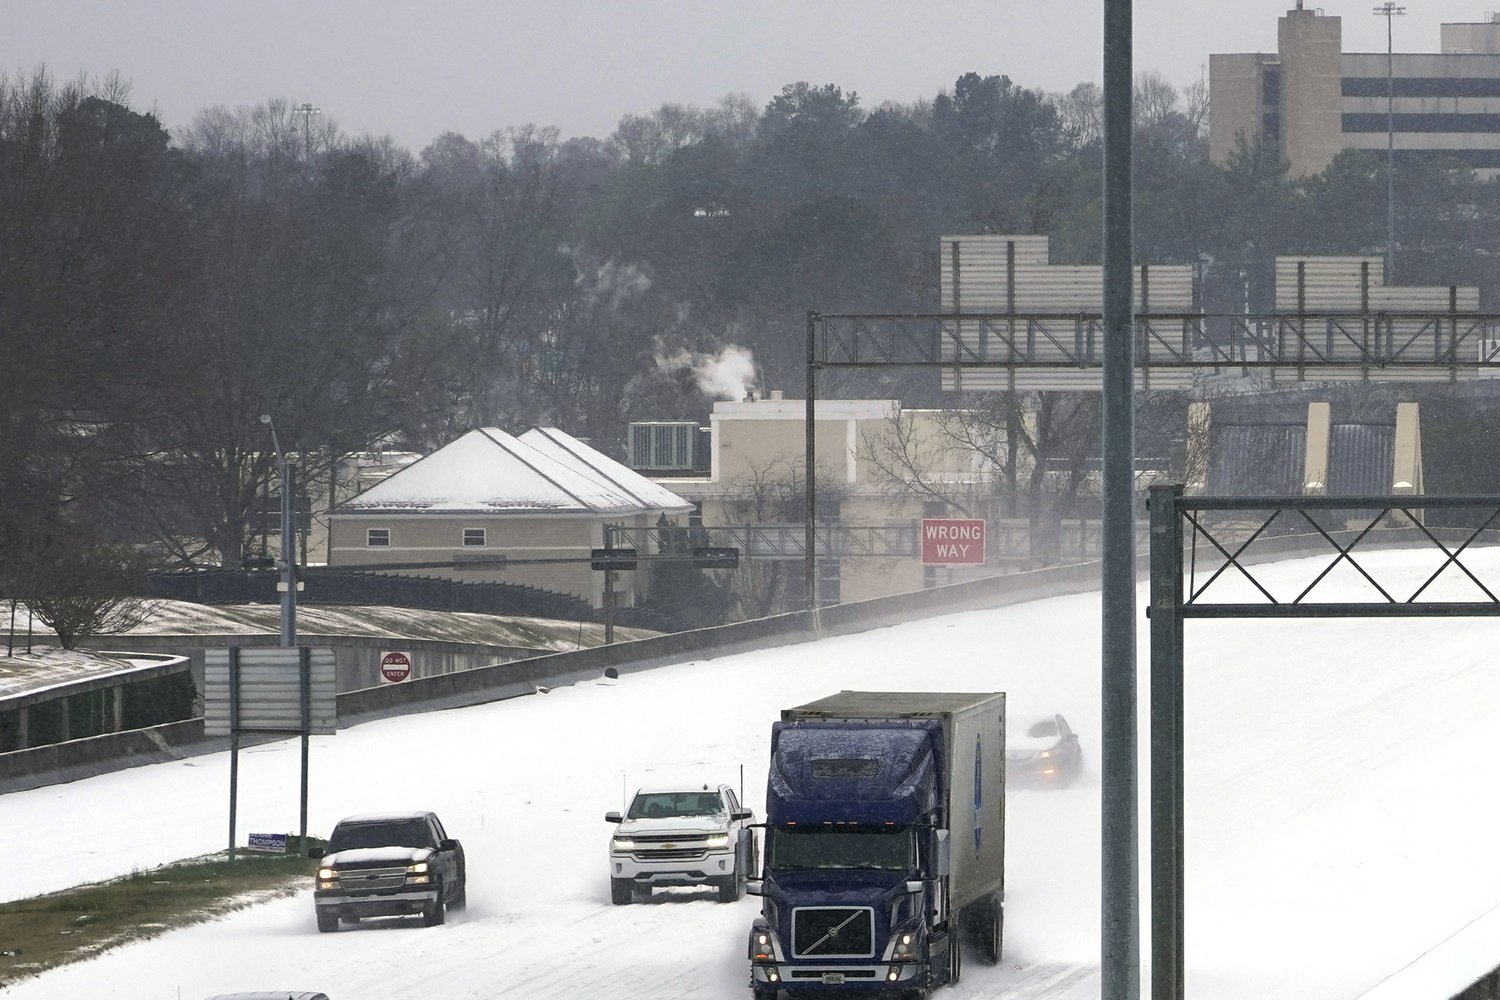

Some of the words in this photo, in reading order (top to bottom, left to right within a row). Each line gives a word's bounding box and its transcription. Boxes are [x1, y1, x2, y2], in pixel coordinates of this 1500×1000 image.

[926, 526, 981, 540] WRONG
[936, 544, 970, 558] WAY
[249, 838, 286, 847] THOMPSON
